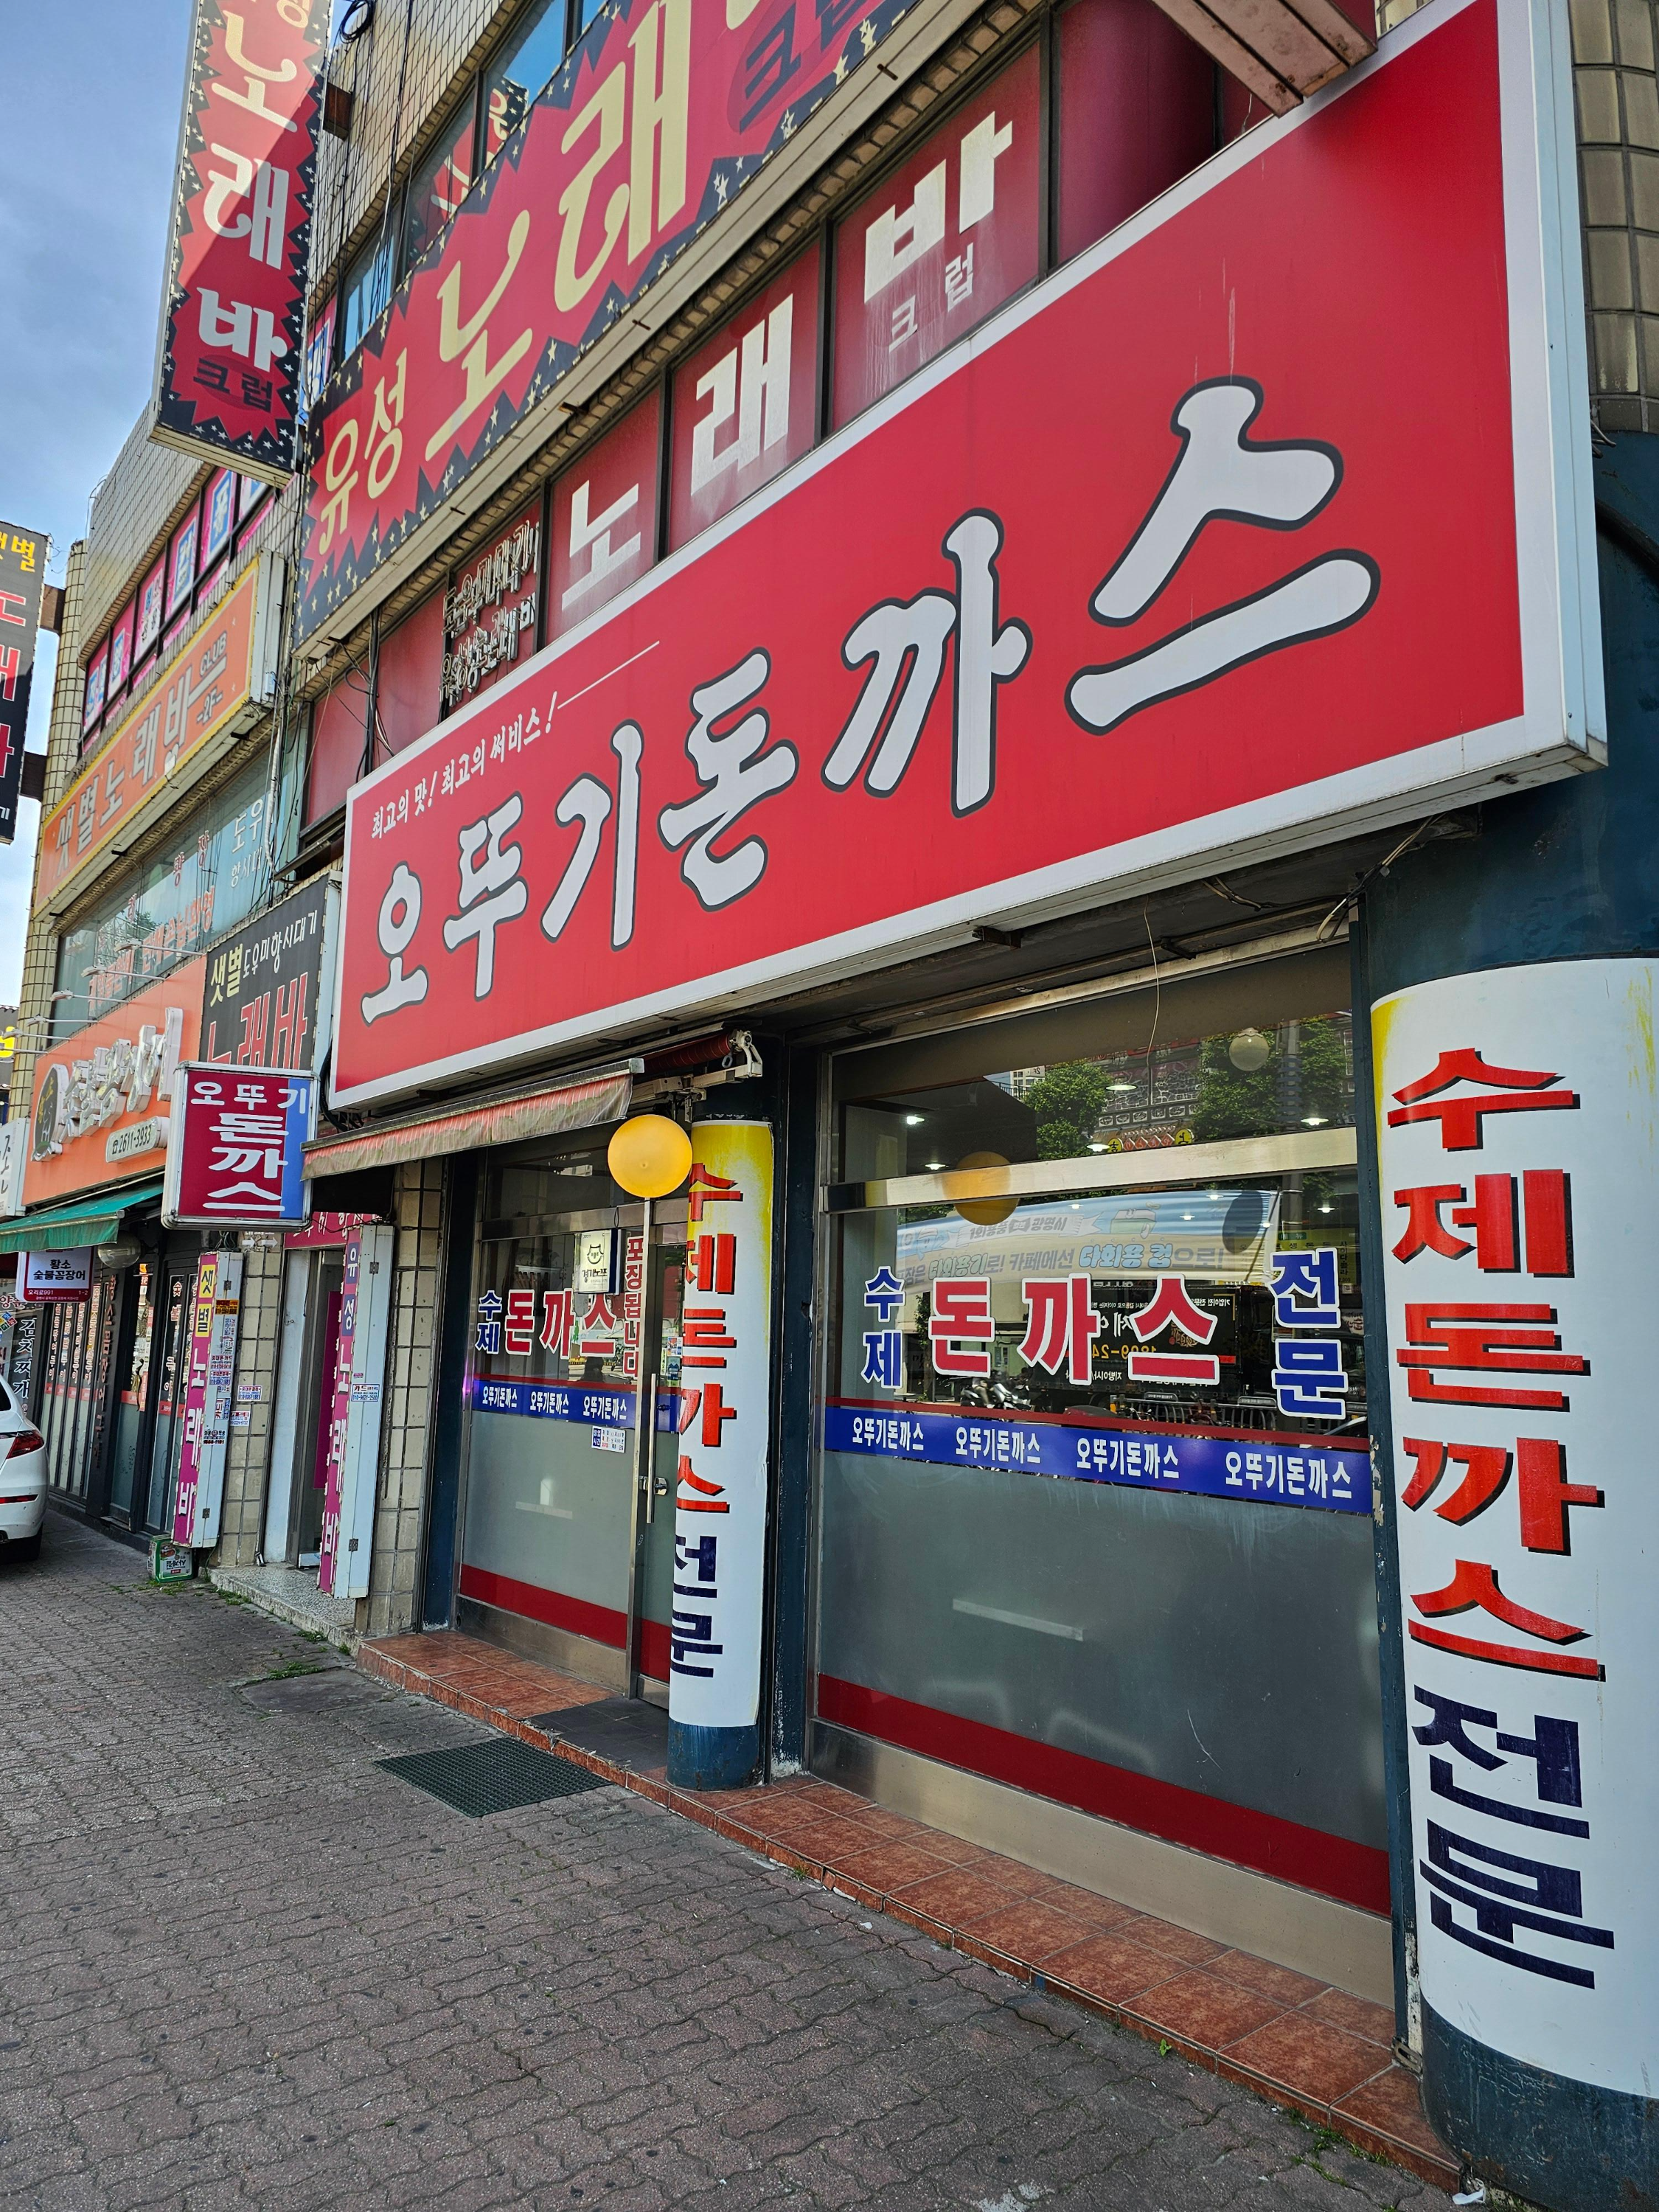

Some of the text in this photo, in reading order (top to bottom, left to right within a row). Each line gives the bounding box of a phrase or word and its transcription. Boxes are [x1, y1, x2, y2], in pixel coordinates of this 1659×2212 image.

[196, 10, 299, 372] 노래바
[319, 0, 759, 555] 유성 노래
[0, 531, 35, 573] 별
[198, 630, 228, 678] CLUB
[361, 375, 1382, 1026] 오뚜기돈까스
[371, 691, 558, 839] 최고의 맛! 최고의 써비스!
[209, 943, 243, 1007] 샛별
[190, 1080, 307, 1115] 오뚜기
[118, 1124, 153, 1155] 2611-3933
[202, 1112, 290, 1213] 돈까스
[1009, 1248, 1075, 1272] 카페에선
[1079, 1243, 1145, 1269] 다회용
[1031, 1217, 1068, 1232] 광명시
[33, 1270, 86, 1281] 숯불꼼장어
[49, 1259, 72, 1269] 황소
[198, 1269, 213, 1333] 샛별
[475, 1290, 501, 1354] 수제
[504, 1288, 618, 1360] 돈까스
[861, 1266, 905, 1389] 수제
[925, 1273, 1220, 1386] 돈까스
[1268, 1247, 1349, 1419] 전문
[325, 1248, 358, 1585] 유성 노래바
[481, 1383, 628, 1422] 오뚜기돈까스 오뚜기돈까스 오뚜기돈까스
[180, 1347, 206, 1539] 노래바
[852, 1416, 1353, 1500] 오뚜기돈까스 오뚜기돈까스 오뚜기돈까스 오뚜기돈까스
[1387, 1047, 1615, 1990] 수제돈까스 전문
